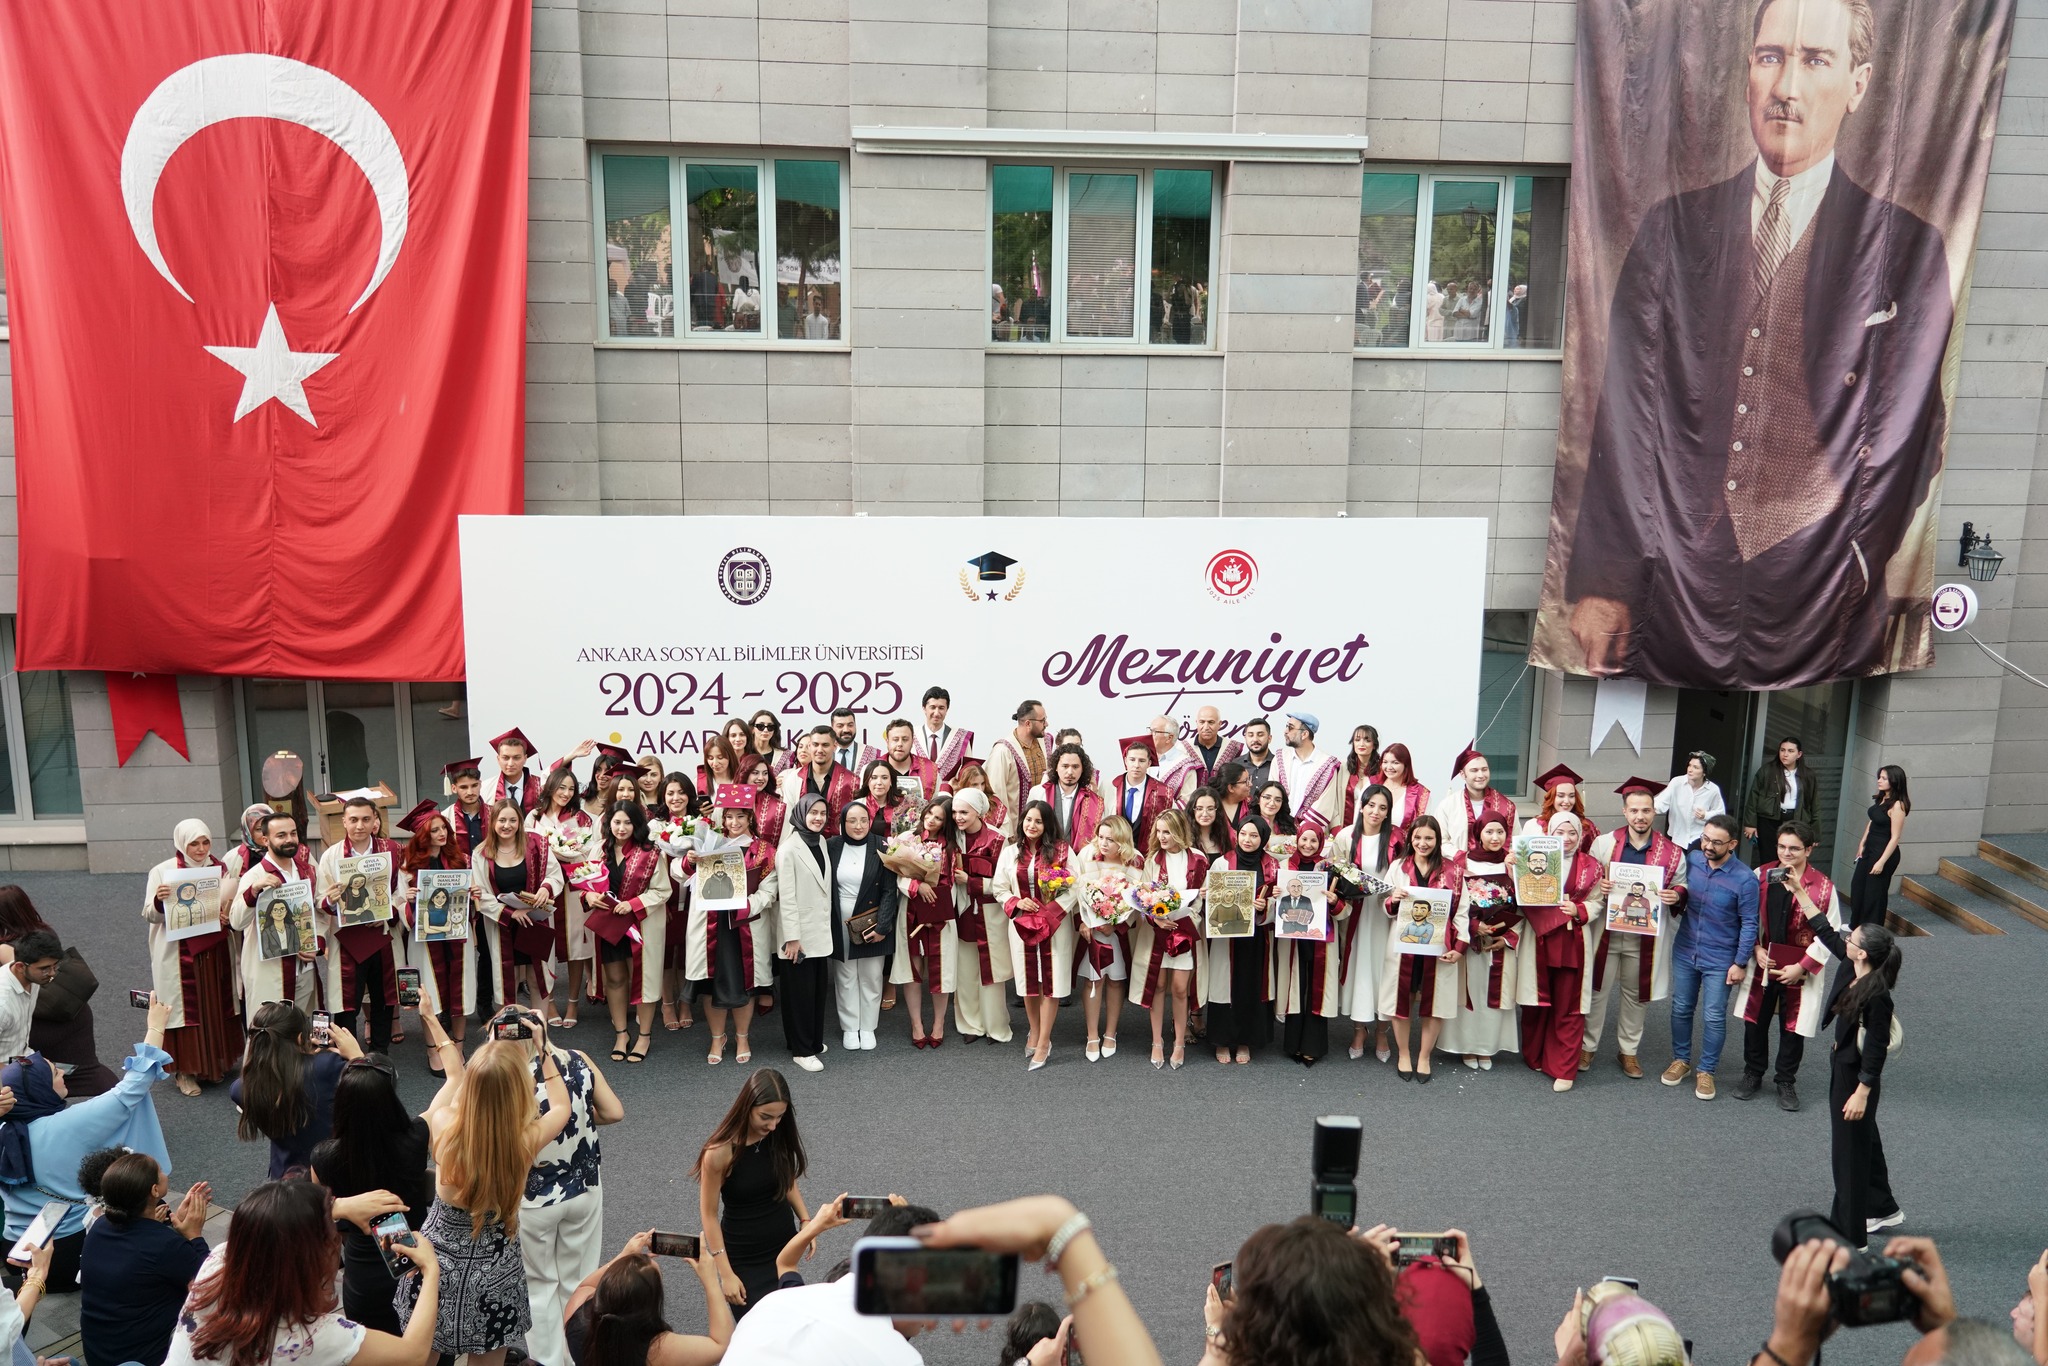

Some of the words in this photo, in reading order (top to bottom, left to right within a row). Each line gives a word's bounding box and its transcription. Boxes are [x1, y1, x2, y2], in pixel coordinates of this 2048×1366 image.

[1206, 587, 1221, 602] 2025
[1243, 588, 1256, 600] YILI
[577, 646, 658, 663] ANKARA
[660, 646, 732, 662] SOSYAL
[734, 643, 812, 662] BİLİMLER
[814, 643, 925, 661] ÜNİVERSİTESİ
[1041, 632, 1370, 712] Mezuniyet
[599, 671, 731, 717] 2024
[776, 671, 904, 715] 2025
